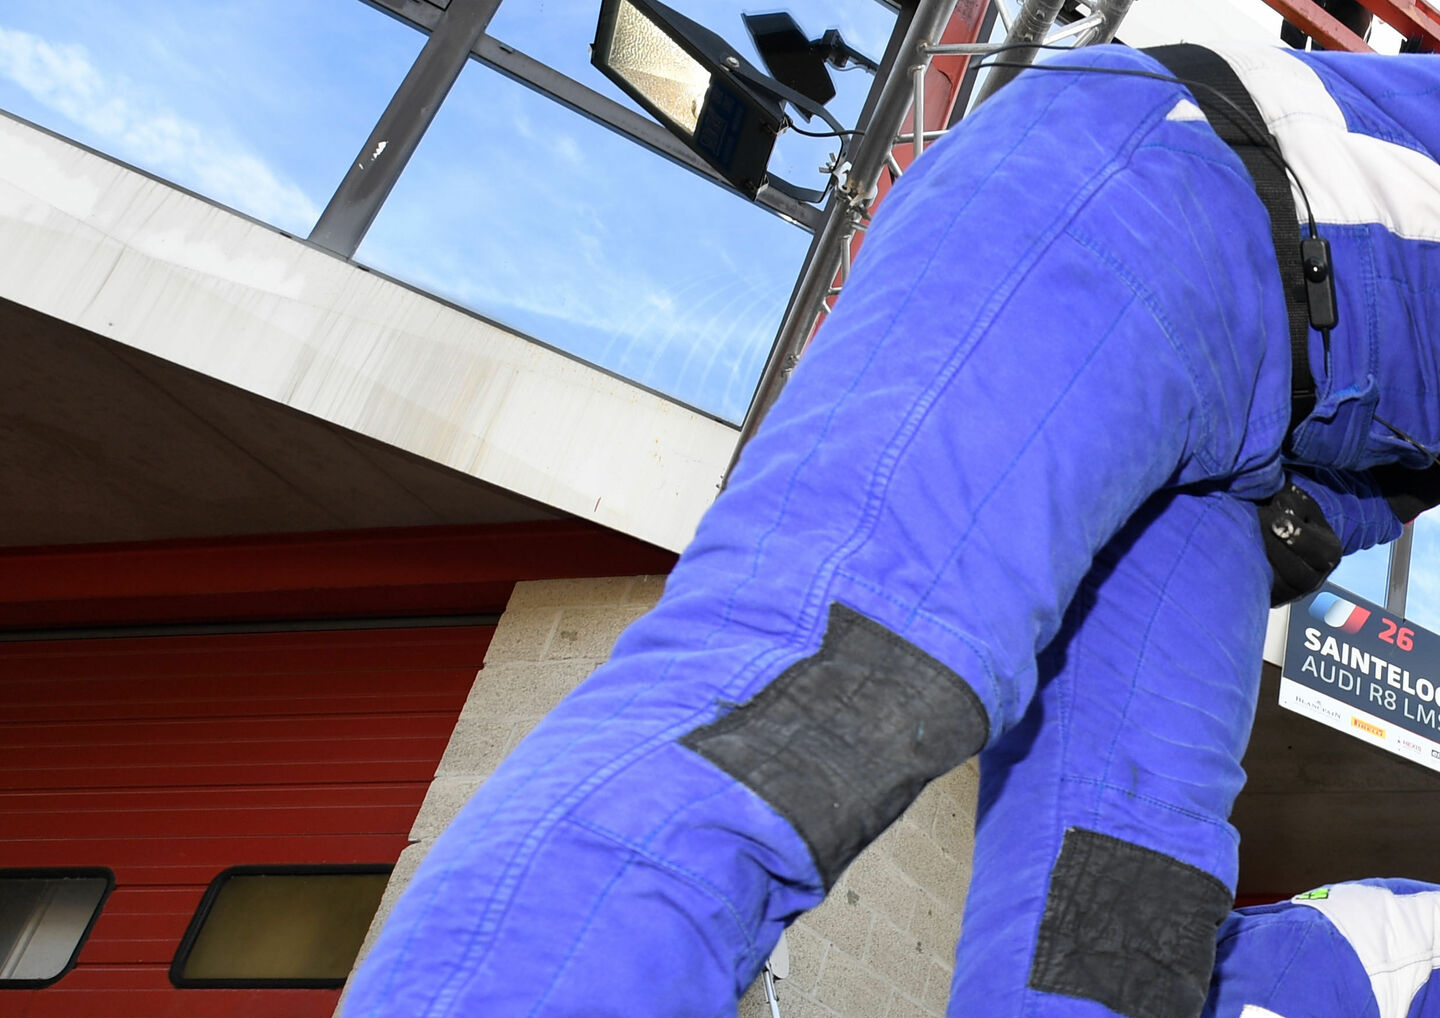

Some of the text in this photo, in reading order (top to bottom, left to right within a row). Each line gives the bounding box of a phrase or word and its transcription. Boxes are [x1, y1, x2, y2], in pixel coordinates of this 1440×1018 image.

[1378, 618, 1415, 652] 26
[1301, 655, 1361, 696] AUDI
[1370, 683, 1397, 711] R8
[1353, 719, 1383, 737] PIRELLI
